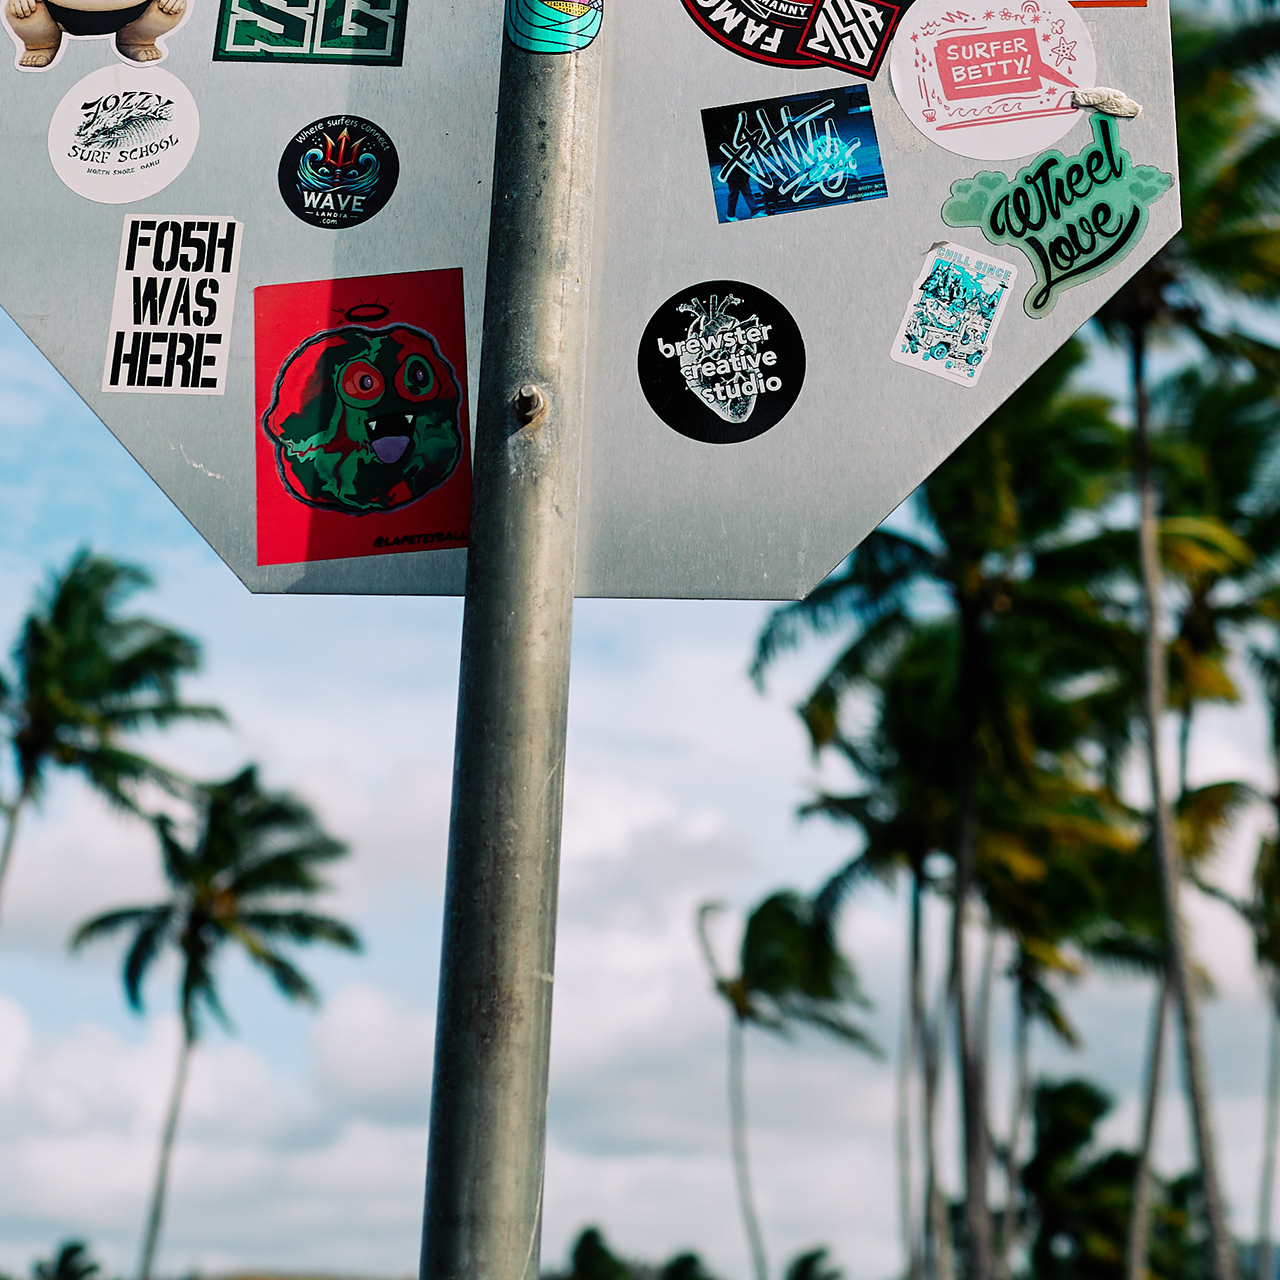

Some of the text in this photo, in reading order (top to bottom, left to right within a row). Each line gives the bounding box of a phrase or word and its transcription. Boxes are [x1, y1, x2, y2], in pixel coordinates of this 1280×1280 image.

[946, 37, 1029, 61] SURFER
[951, 54, 1032, 83] BETTY!
[80, 91, 175, 131] JOZZY
[67, 134, 180, 164] SURF SCHOOL
[294, 116, 391, 152] Where surfers connect
[86, 167, 111, 176] NORTH
[112, 167, 136, 176] SHORE
[989, 119, 1123, 238] Wheel
[302, 191, 367, 213] WAVE
[315, 211, 348, 219] LANDIA
[936, 247, 1013, 281] CHILL SINCE
[1024, 202, 1141, 310] Love
[132, 276, 220, 327] WAS
[657, 324, 773, 359] brewster
[109, 331, 223, 389] HERE
[680, 349, 778, 381] creative
[701, 372, 783, 404] studio
